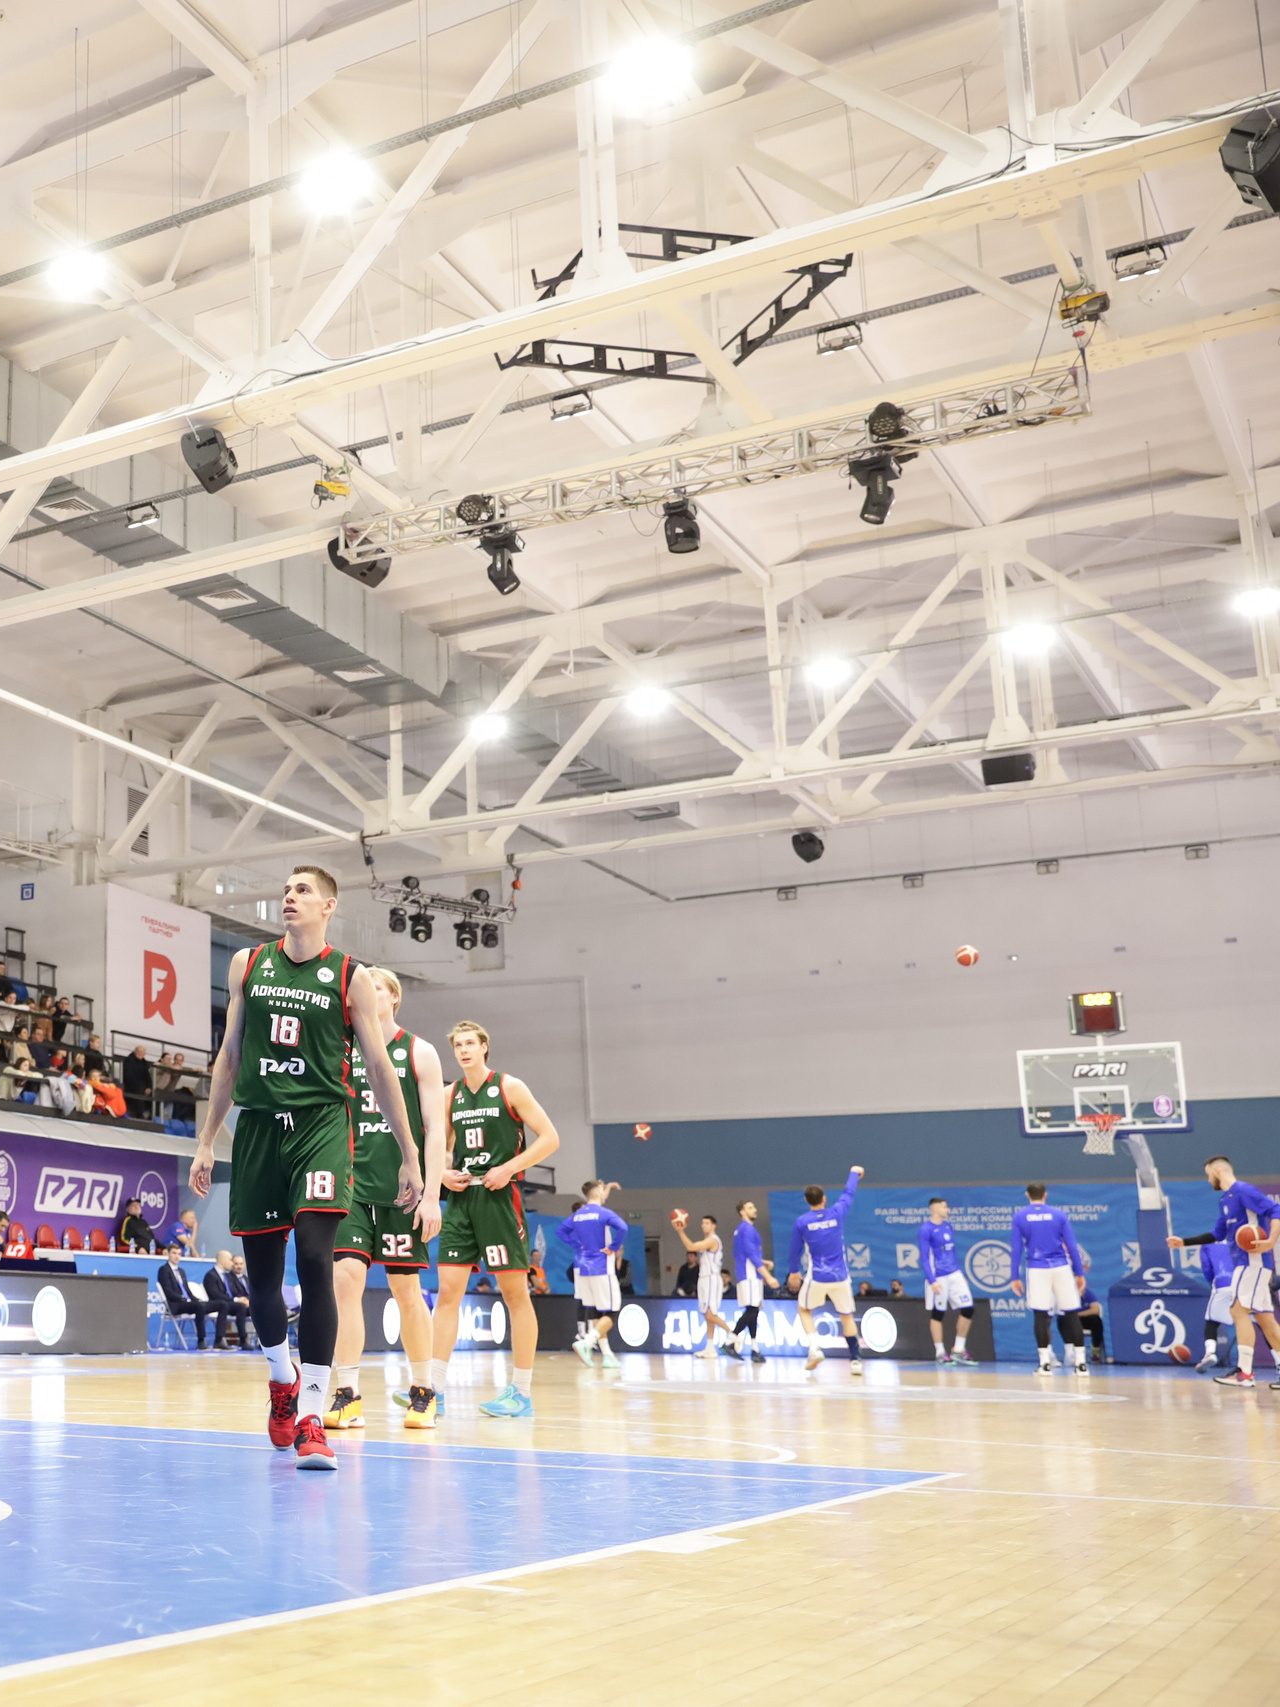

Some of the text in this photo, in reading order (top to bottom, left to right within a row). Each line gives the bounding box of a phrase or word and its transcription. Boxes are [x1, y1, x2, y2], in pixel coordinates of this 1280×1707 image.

[250, 984, 331, 1010] ЛОКОМОТИВ
[268, 999, 306, 1011] КУБАНЬ
[270, 1013, 302, 1047] 18
[1073, 1062, 1127, 1078] PARI
[465, 1127, 485, 1149] 81
[39, 1174, 118, 1211] PARI
[305, 1170, 336, 1201] 18
[140, 1191, 165, 1208] РФБ
[382, 1234, 414, 1258] 32
[485, 1244, 509, 1268] 81
